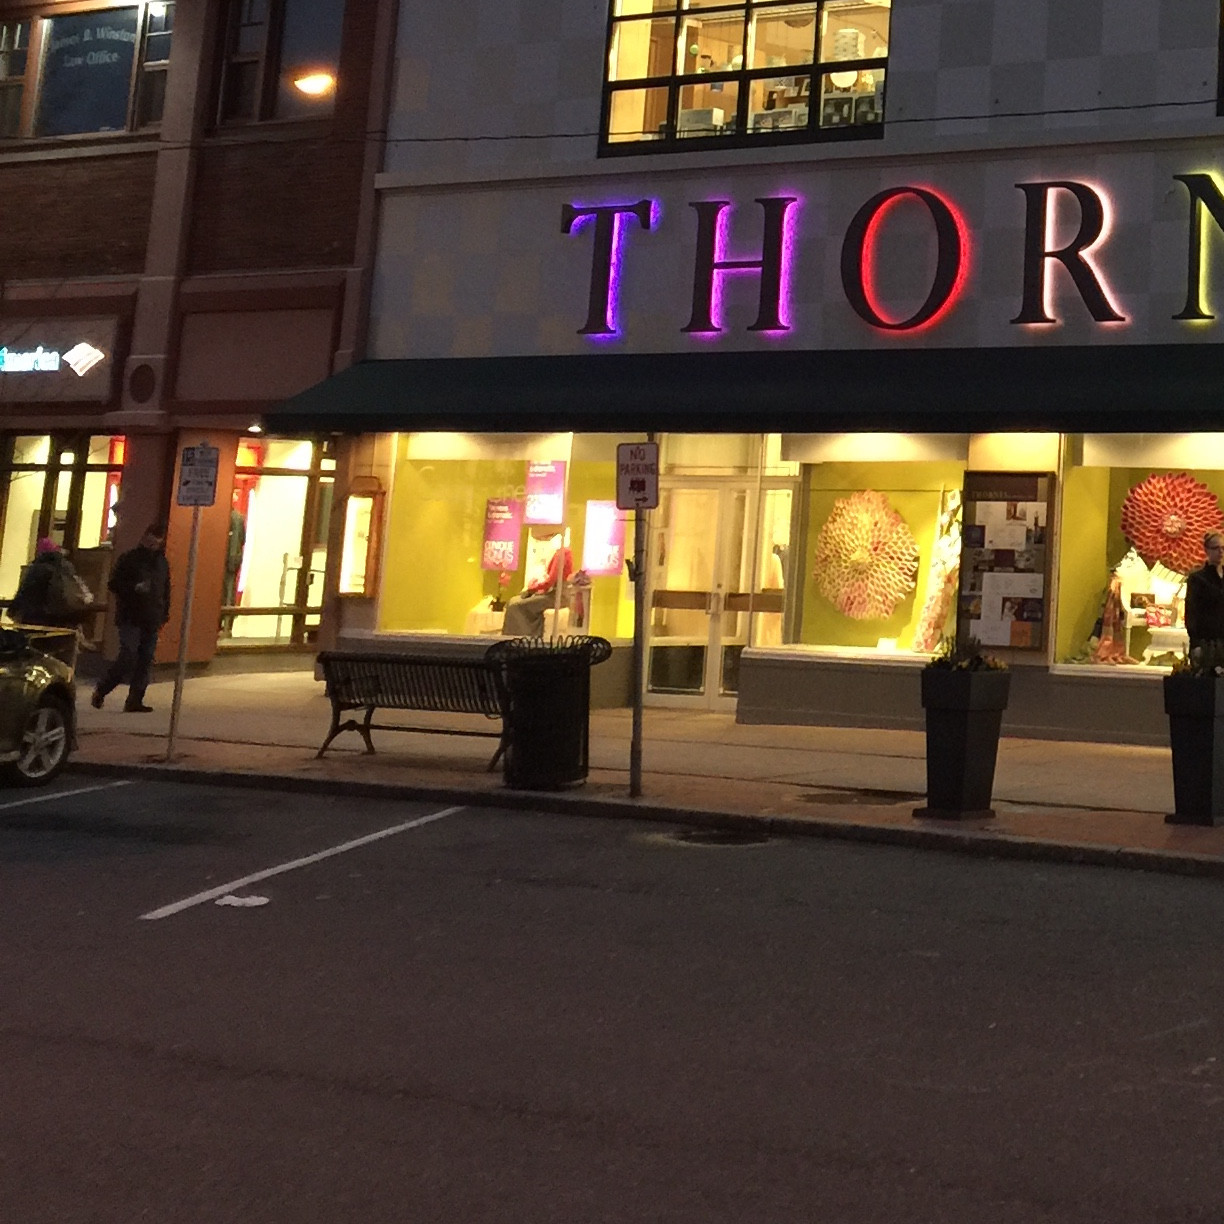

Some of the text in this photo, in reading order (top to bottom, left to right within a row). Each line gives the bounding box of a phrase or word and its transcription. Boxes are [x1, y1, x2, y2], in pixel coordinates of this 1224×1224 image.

[86, 49, 118, 64] Office
[630, 448, 646, 461] NO
[620, 462, 656, 476] PARKING
